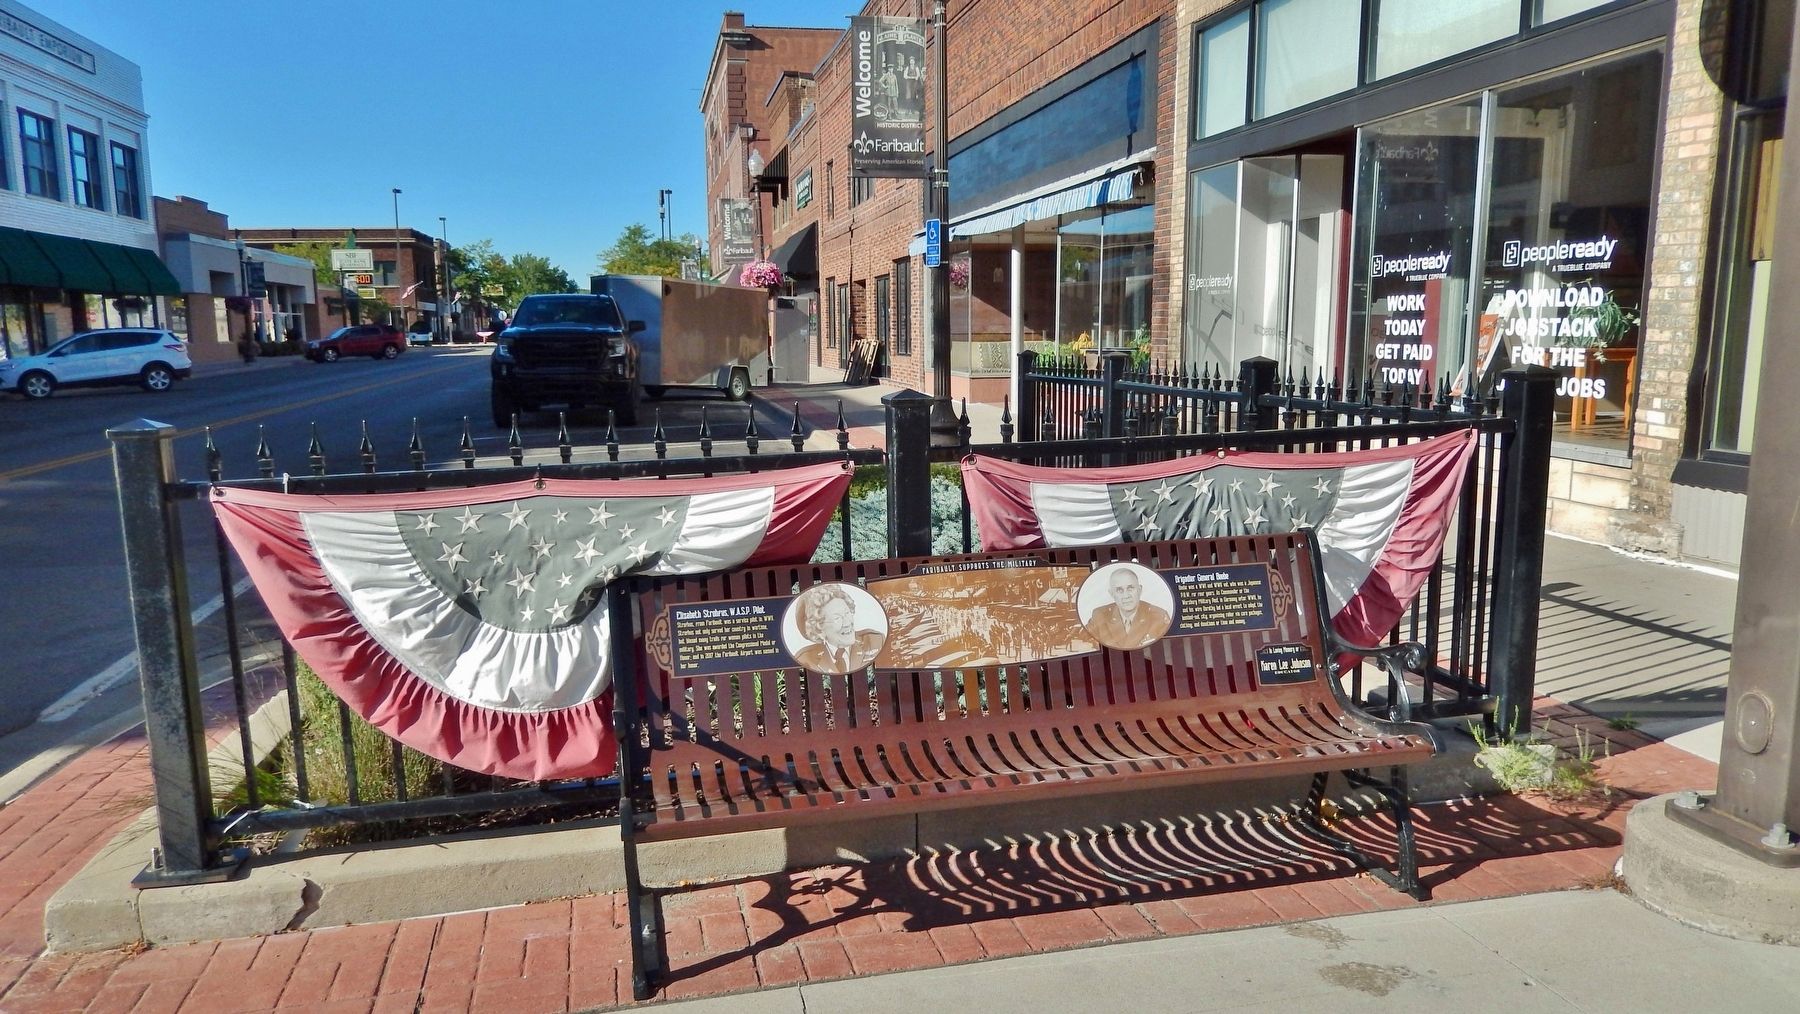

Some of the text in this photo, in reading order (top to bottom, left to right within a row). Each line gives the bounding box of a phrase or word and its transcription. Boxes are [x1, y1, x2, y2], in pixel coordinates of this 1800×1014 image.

[855, 30, 871, 118] Welcome
[875, 138, 925, 153] Faribault
[724, 203, 732, 240] Welcome
[1521, 235, 1618, 268] peopleready
[1384, 250, 1452, 278] peopleready
[1557, 264, 1584, 272] TRUEBLUE
[1585, 262, 1612, 270] COMPANY
[1195, 273, 1233, 291] peopleready
[1387, 294, 1426, 312] WORK
[1505, 287, 1604, 308] DOWNLOAD
[1384, 319, 1427, 336] TODAY
[1505, 317, 1598, 337] JOBSTACK
[1375, 343, 1433, 360] GET PAID
[1511, 346, 1586, 367] FOR THE
[1382, 367, 1424, 386] TODAY
[1556, 377, 1606, 399] JOBS
[922, 564, 956, 575] FARIBAULT
[958, 563, 990, 571] SUPPORTS
[1007, 559, 1037, 567] MILITARY
[1196, 573, 1215, 581] General
[729, 606, 751, 616] W.A.S.P.
[1260, 658, 1311, 671] Karen Lee Johnson
